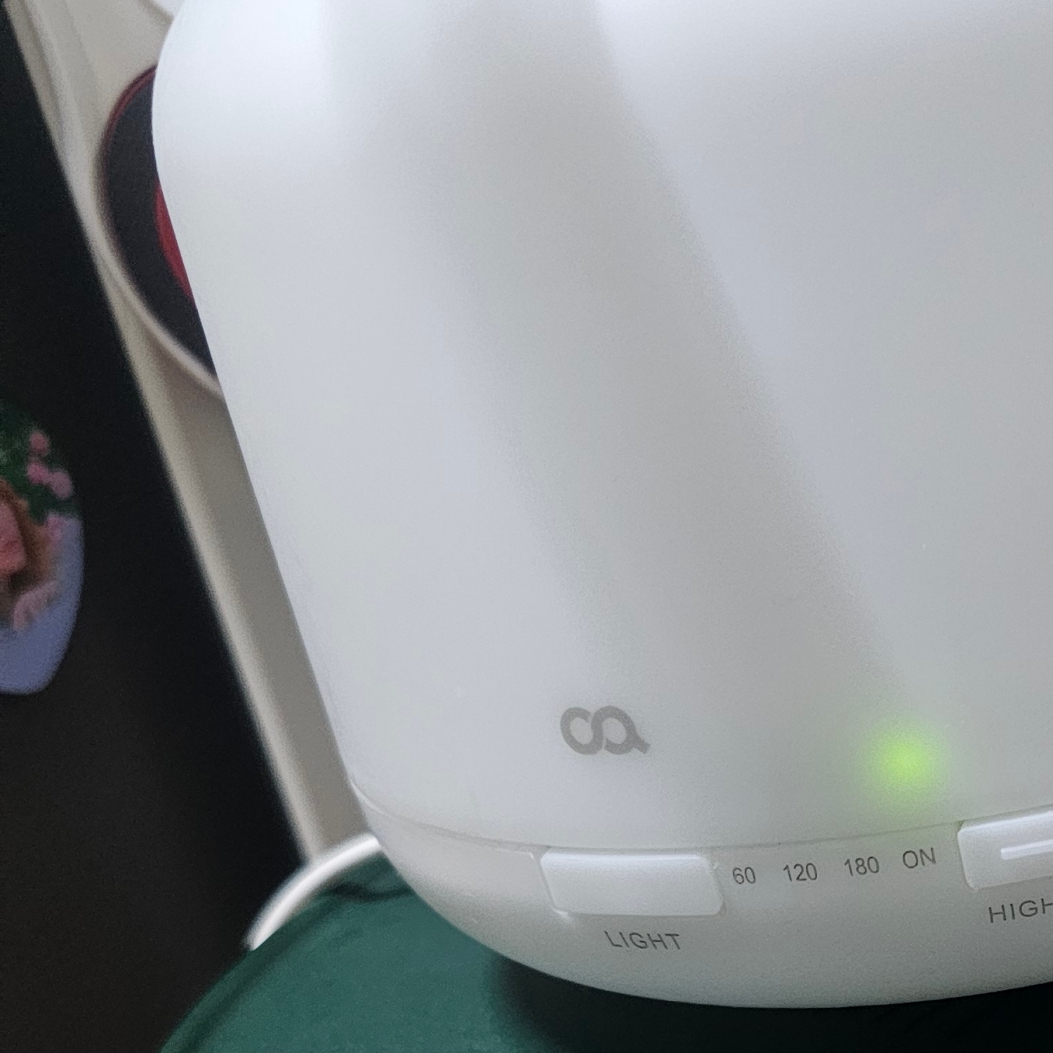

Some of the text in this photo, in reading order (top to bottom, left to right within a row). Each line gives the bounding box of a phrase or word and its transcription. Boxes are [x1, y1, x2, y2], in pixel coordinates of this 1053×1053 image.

[732, 846, 937, 885] 60 120 180 ON
[604, 930, 682, 951] LIGHT
